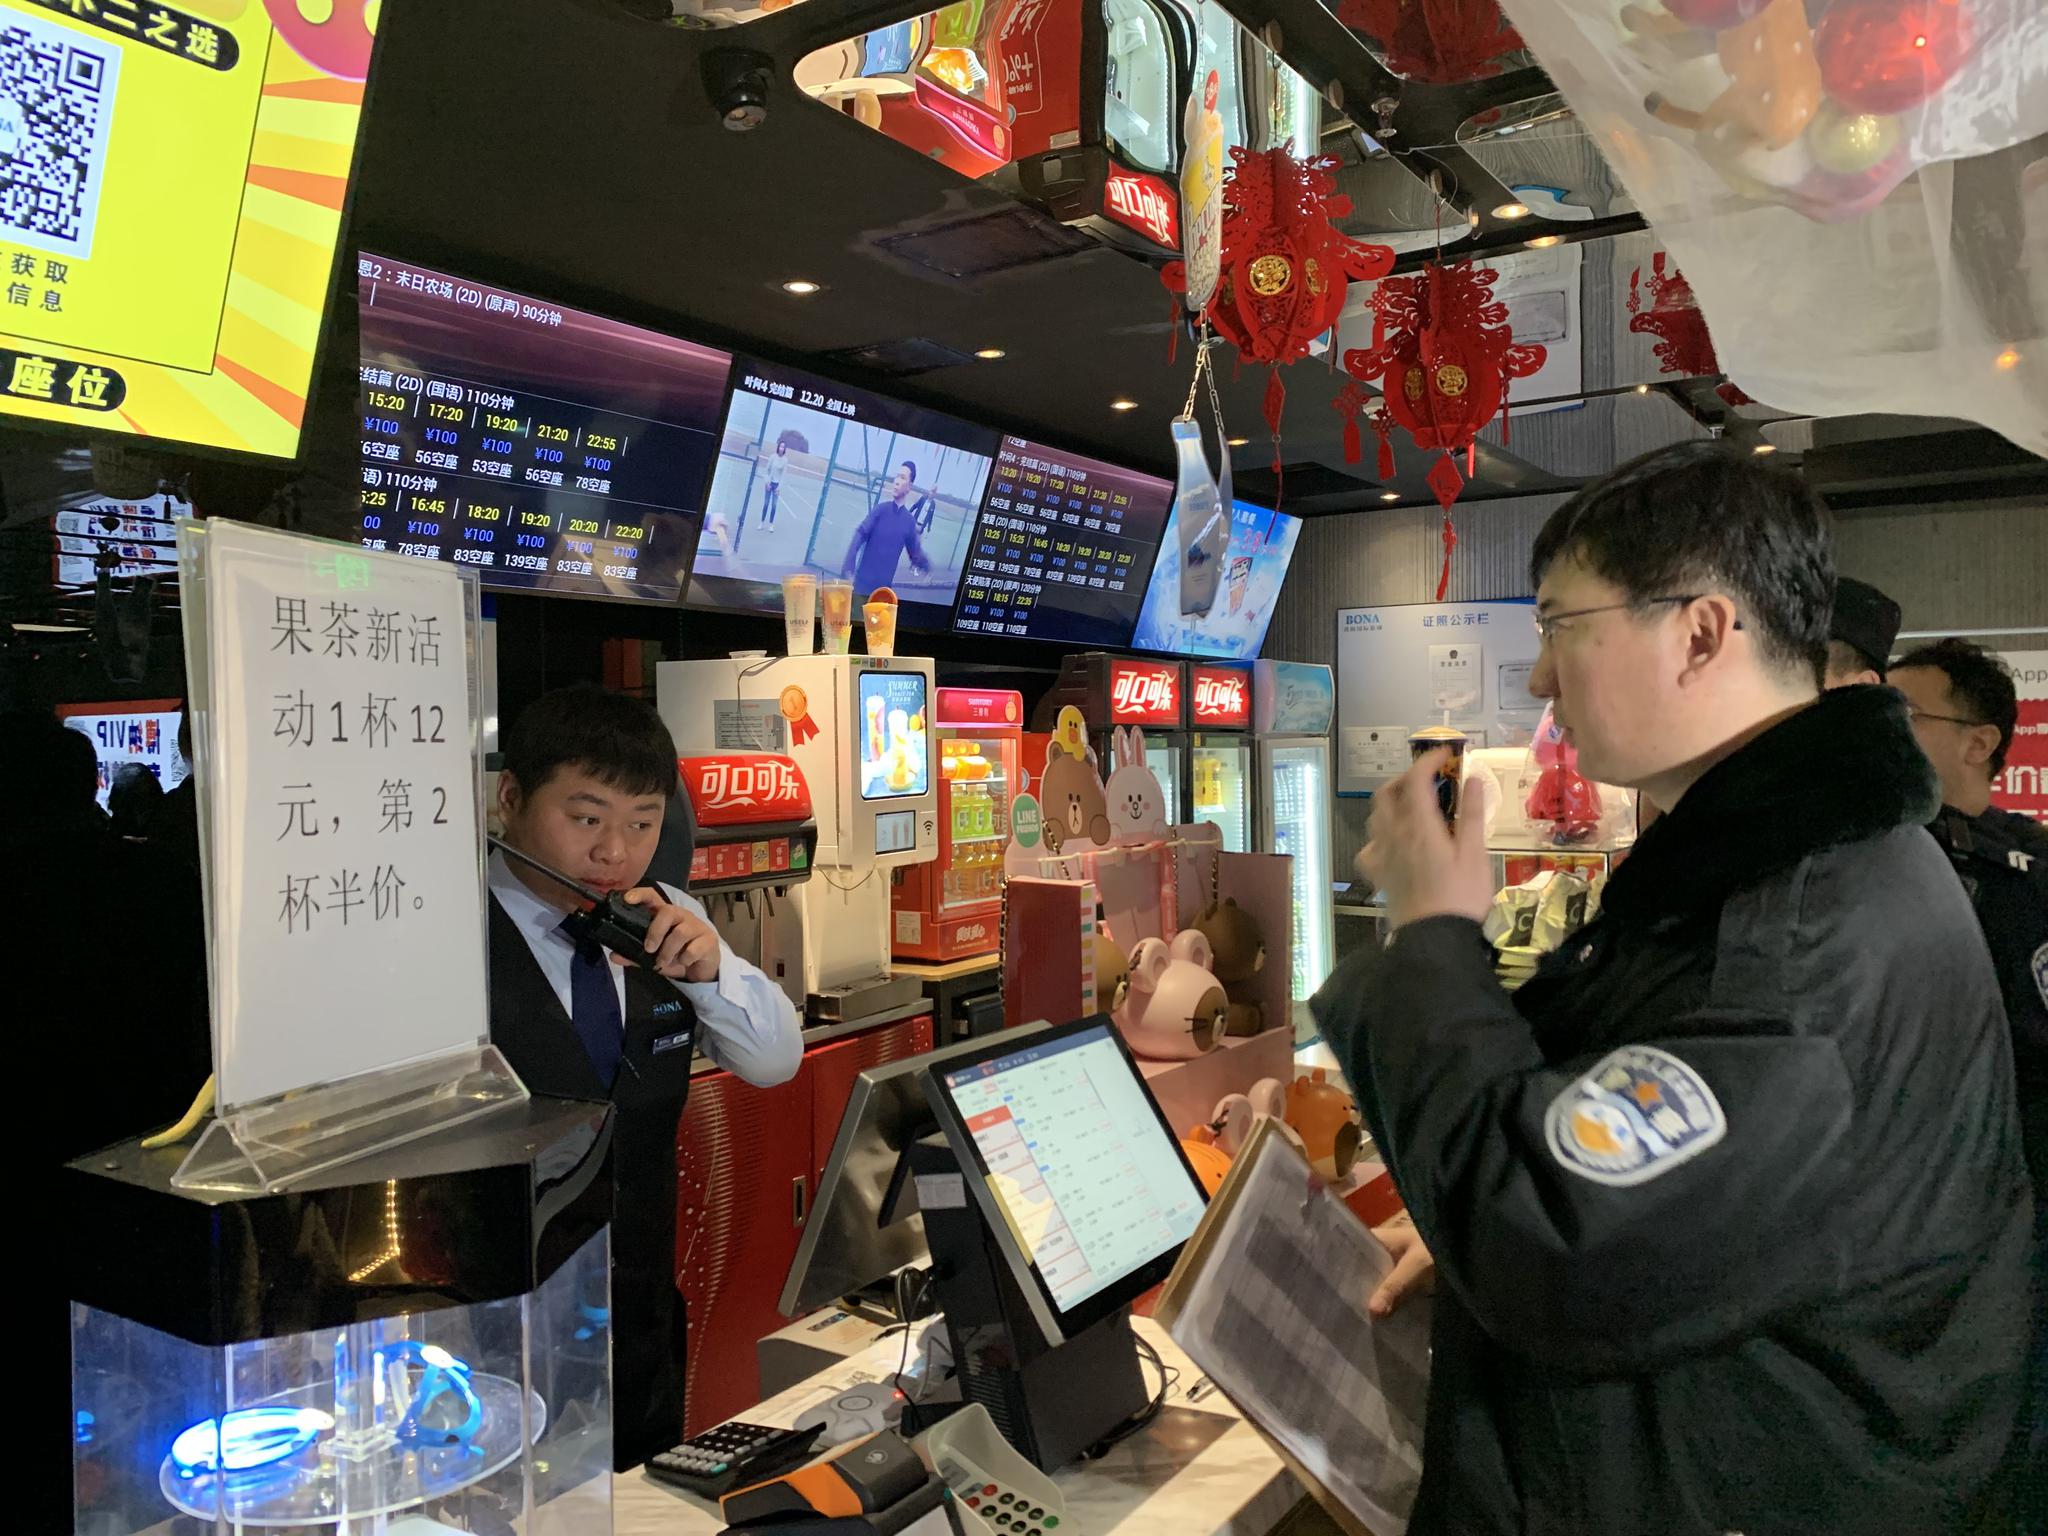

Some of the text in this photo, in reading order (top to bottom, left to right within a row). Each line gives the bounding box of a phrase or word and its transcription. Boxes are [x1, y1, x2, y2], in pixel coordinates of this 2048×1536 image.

[7, 281, 63, 312] 信息
[455, 286, 482, 308] (2D)
[485, 294, 520, 318] (原声)
[522, 305, 562, 327] 90分钟
[7, 356, 110, 407] 座位
[396, 374, 424, 395] (2D)
[426, 380, 464, 403] (国语)
[466, 389, 515, 411] 110分钟
[799, 390, 824, 407] 12.20
[367, 391, 617, 451] 15:20 17:20 19:20 21:20 22:55
[364, 416, 611, 471] ¥100 ¥100 ¥100 ¥100 ¥100
[361, 441, 611, 494] 6空座 56空座 53空座 56空座 78空座
[386, 472, 437, 492] 110分钟
[410, 497, 445, 514] 16:45
[467, 505, 500, 521] 18:20
[520, 512, 551, 527] 19:20
[569, 519, 599, 534] 20:20
[615, 525, 643, 540] 22:20
[407, 520, 439, 536] ¥100
[463, 527, 494, 542] ¥100
[517, 533, 545, 548] ¥100
[565, 540, 593, 554] ¥100
[613, 545, 638, 560] ¥100
[398, 542, 441, 560] 78空座
[453, 549, 495, 566] 83空座
[504, 553, 549, 571] 139空座
[556, 560, 593, 576] 83空座
[603, 565, 639, 580] 83空座
[270, 595, 442, 667] 果茶新活
[1345, 613, 1380, 625] BONA
[1422, 612, 1490, 628] 证照公示栏
[1114, 670, 1177, 713] 可口可乐
[1193, 676, 1247, 714] 可口可乐
[700, 760, 801, 806] 可口可乐
[1016, 810, 1037, 824] LINE
[277, 863, 425, 935] 杯半价。
